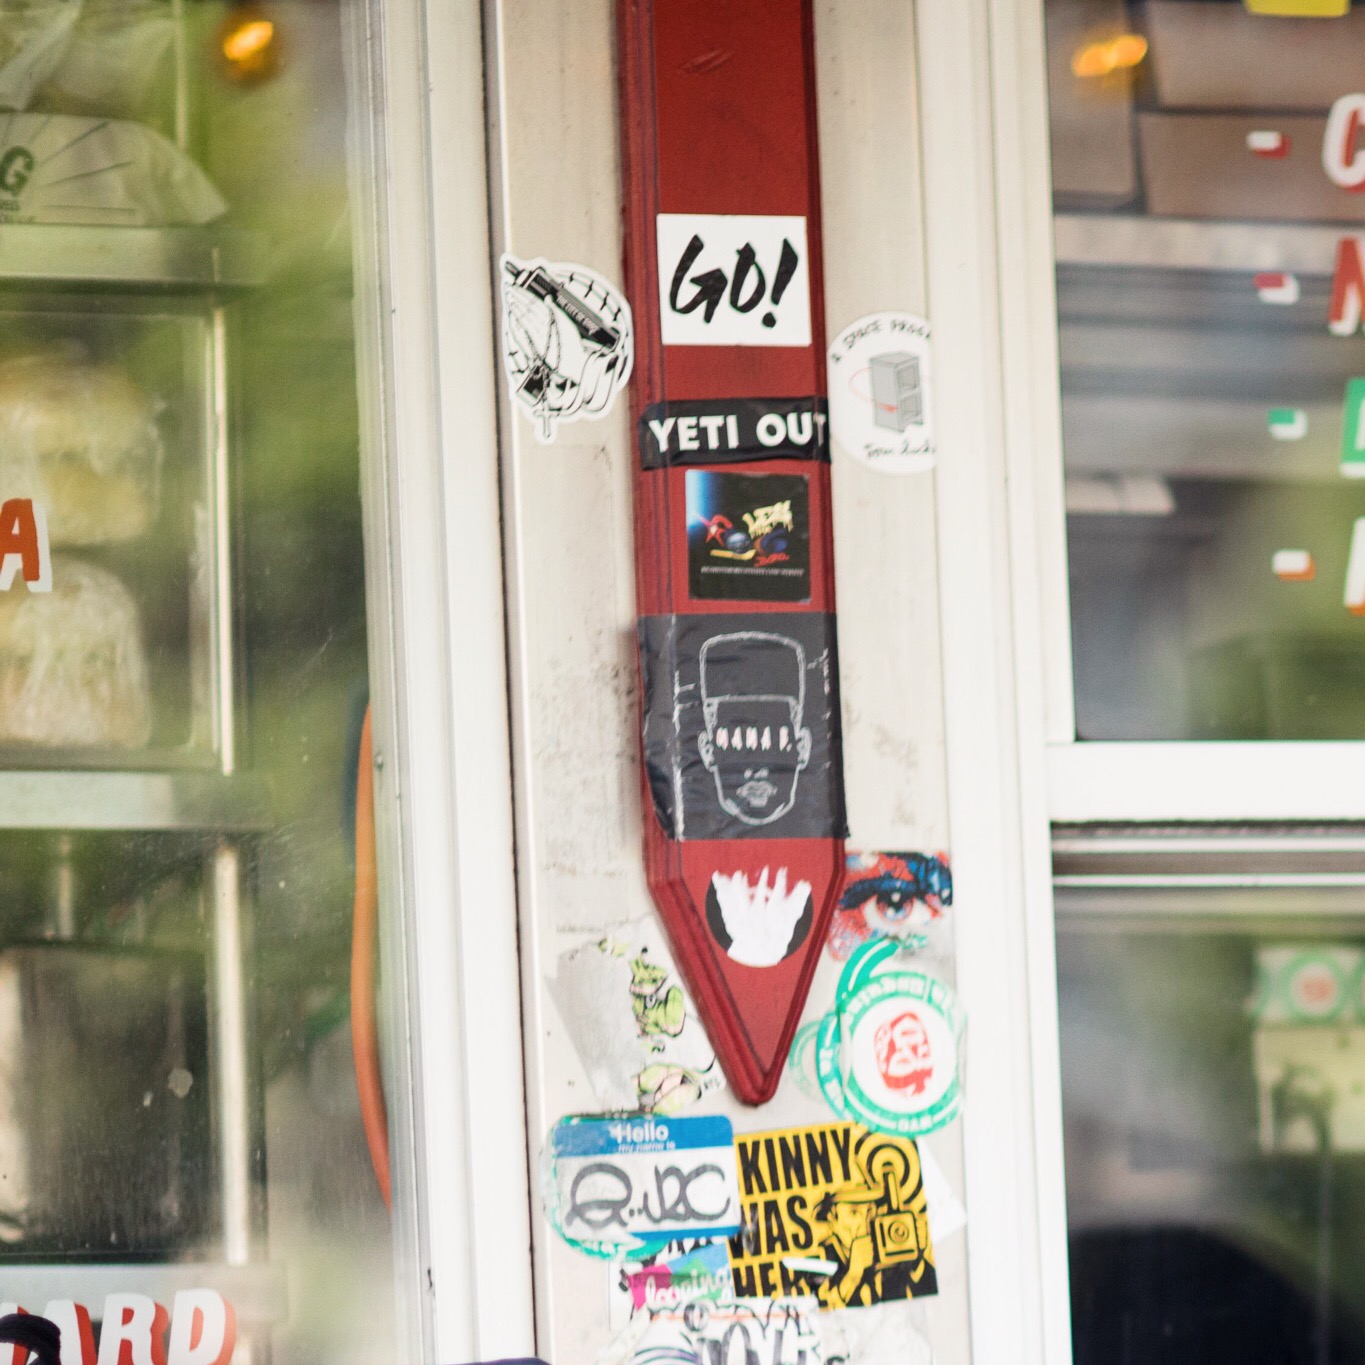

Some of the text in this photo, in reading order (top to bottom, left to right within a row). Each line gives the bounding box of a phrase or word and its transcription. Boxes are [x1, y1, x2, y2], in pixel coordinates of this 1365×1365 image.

[669, 233, 799, 329] GO!
[648, 410, 828, 454] YETI OUT
[611, 1121, 669, 1143] Hello
[729, 1195, 813, 1259] WAS
[733, 1256, 817, 1298] HER
